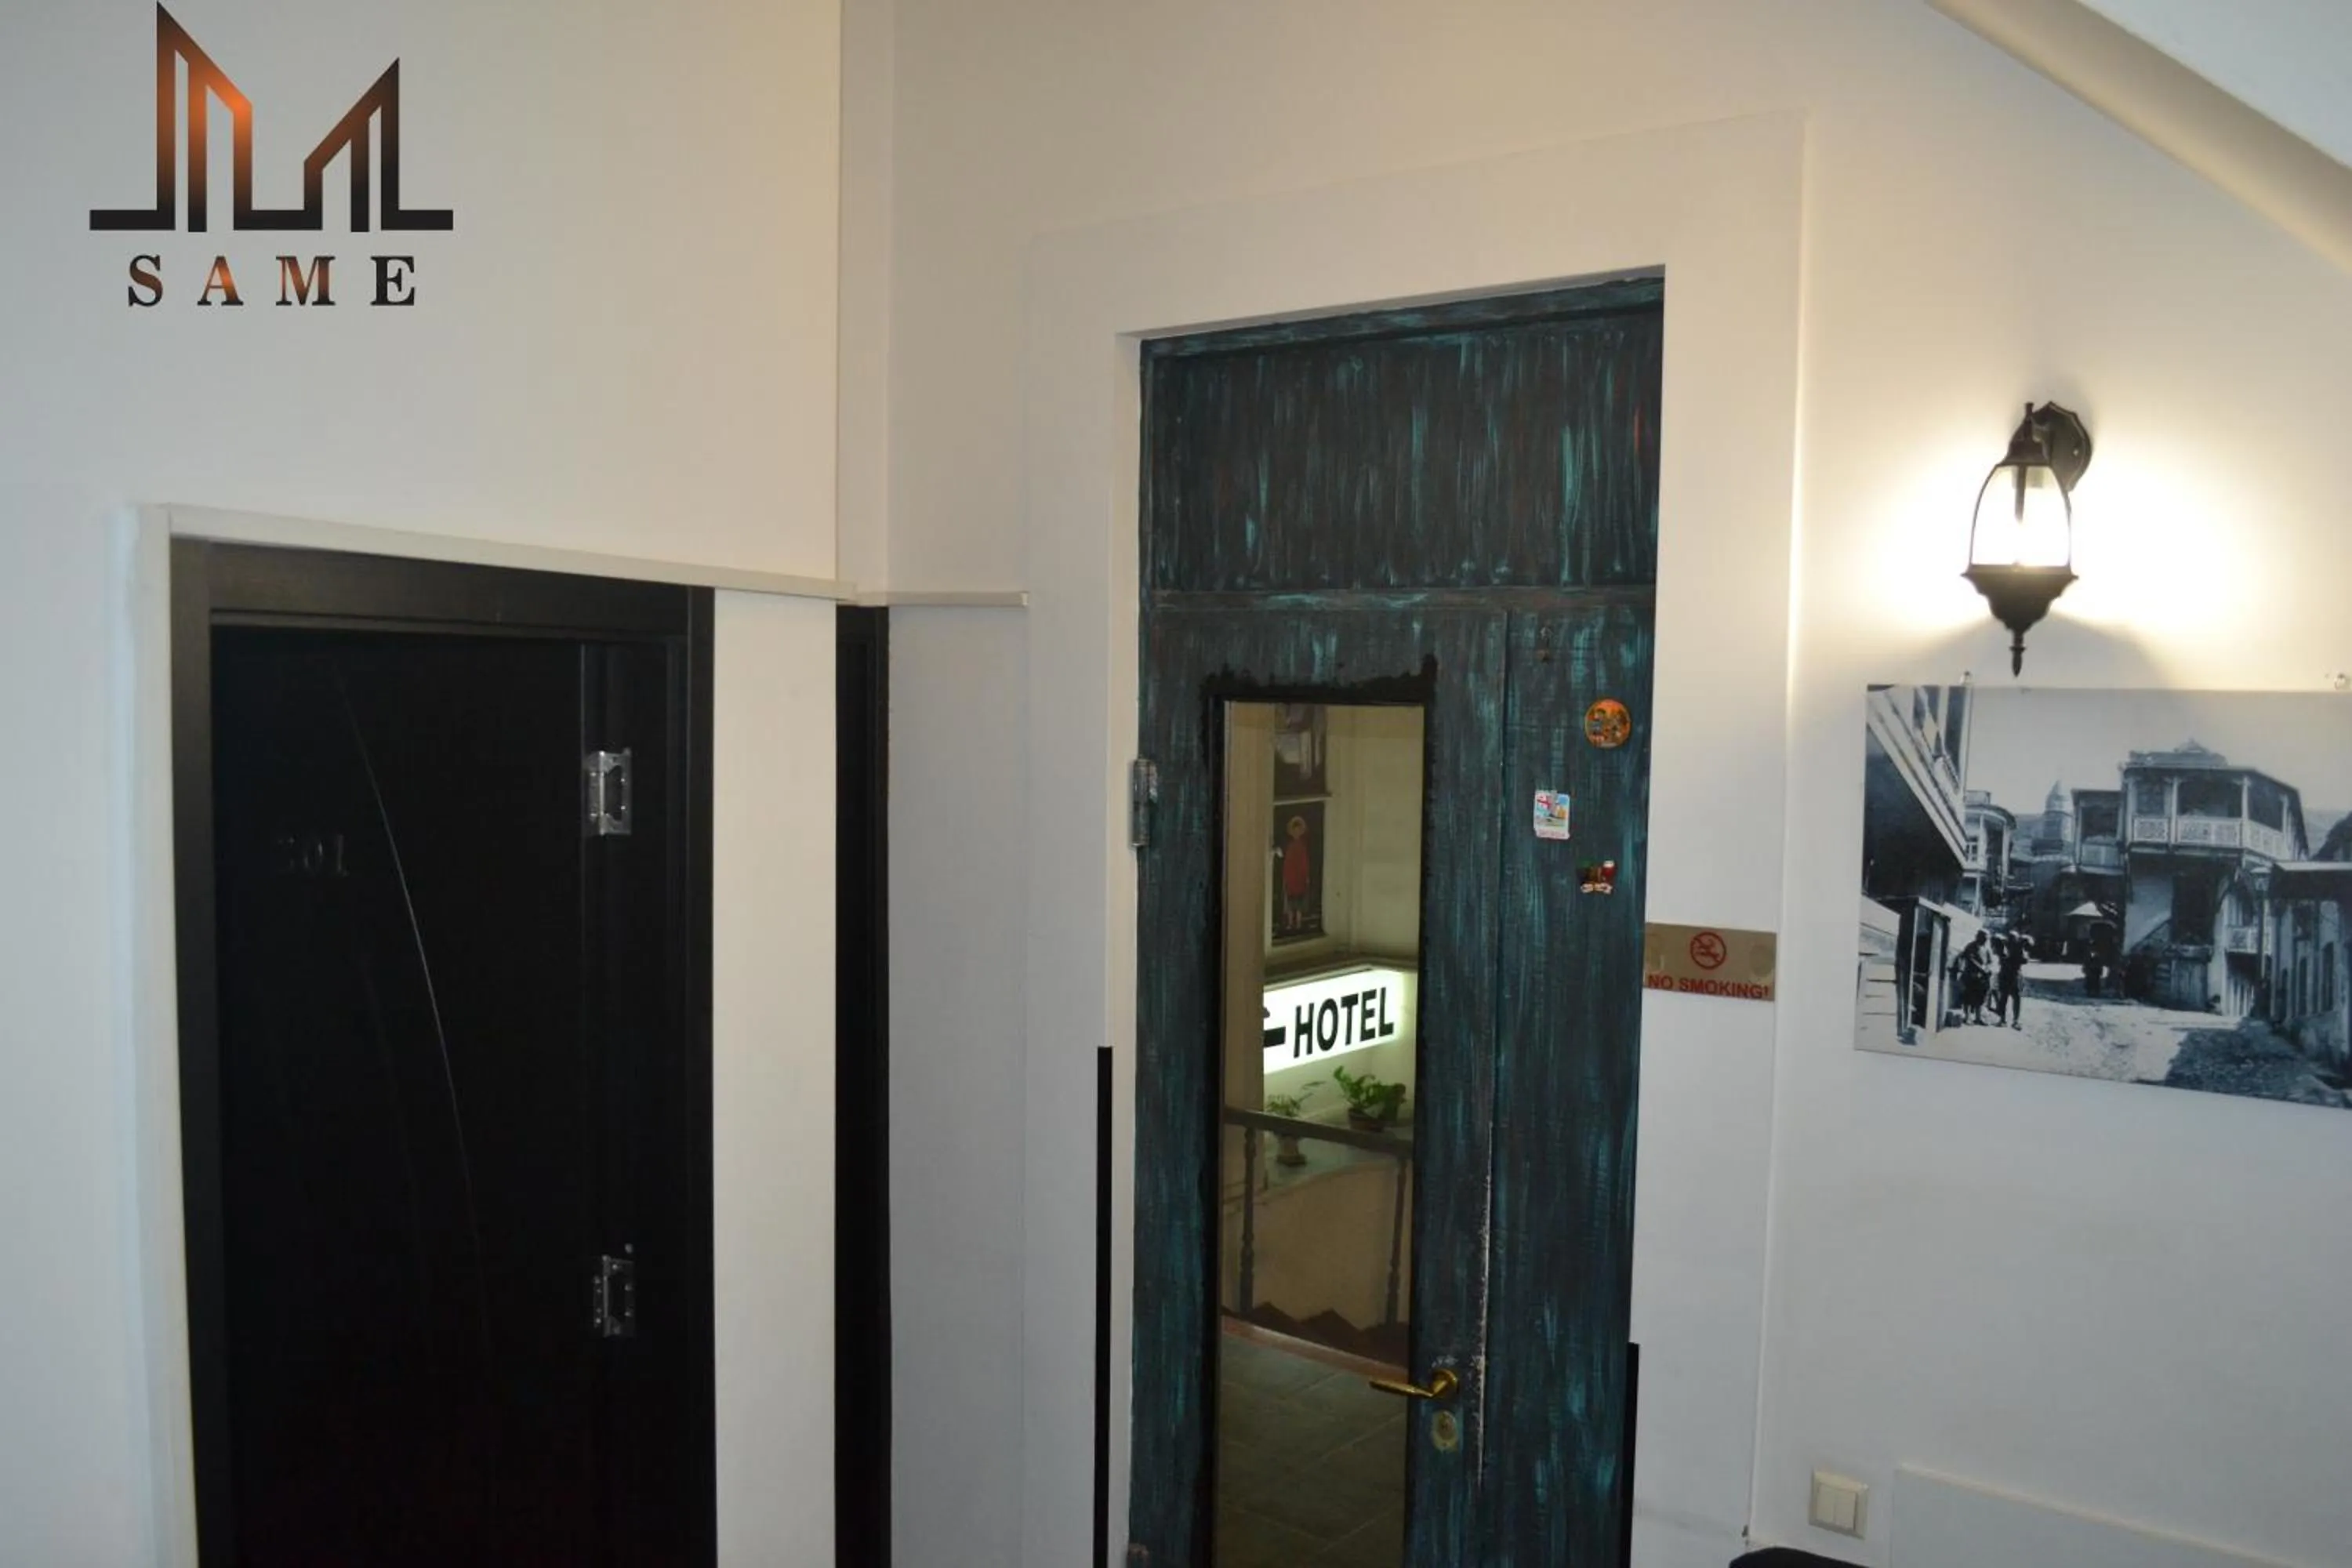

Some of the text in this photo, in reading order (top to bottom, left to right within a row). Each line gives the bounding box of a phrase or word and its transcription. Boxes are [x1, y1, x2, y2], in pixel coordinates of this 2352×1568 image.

[1648, 974, 1769, 999] NO SMOKING!
[1293, 986, 1395, 1058] HOTEL
